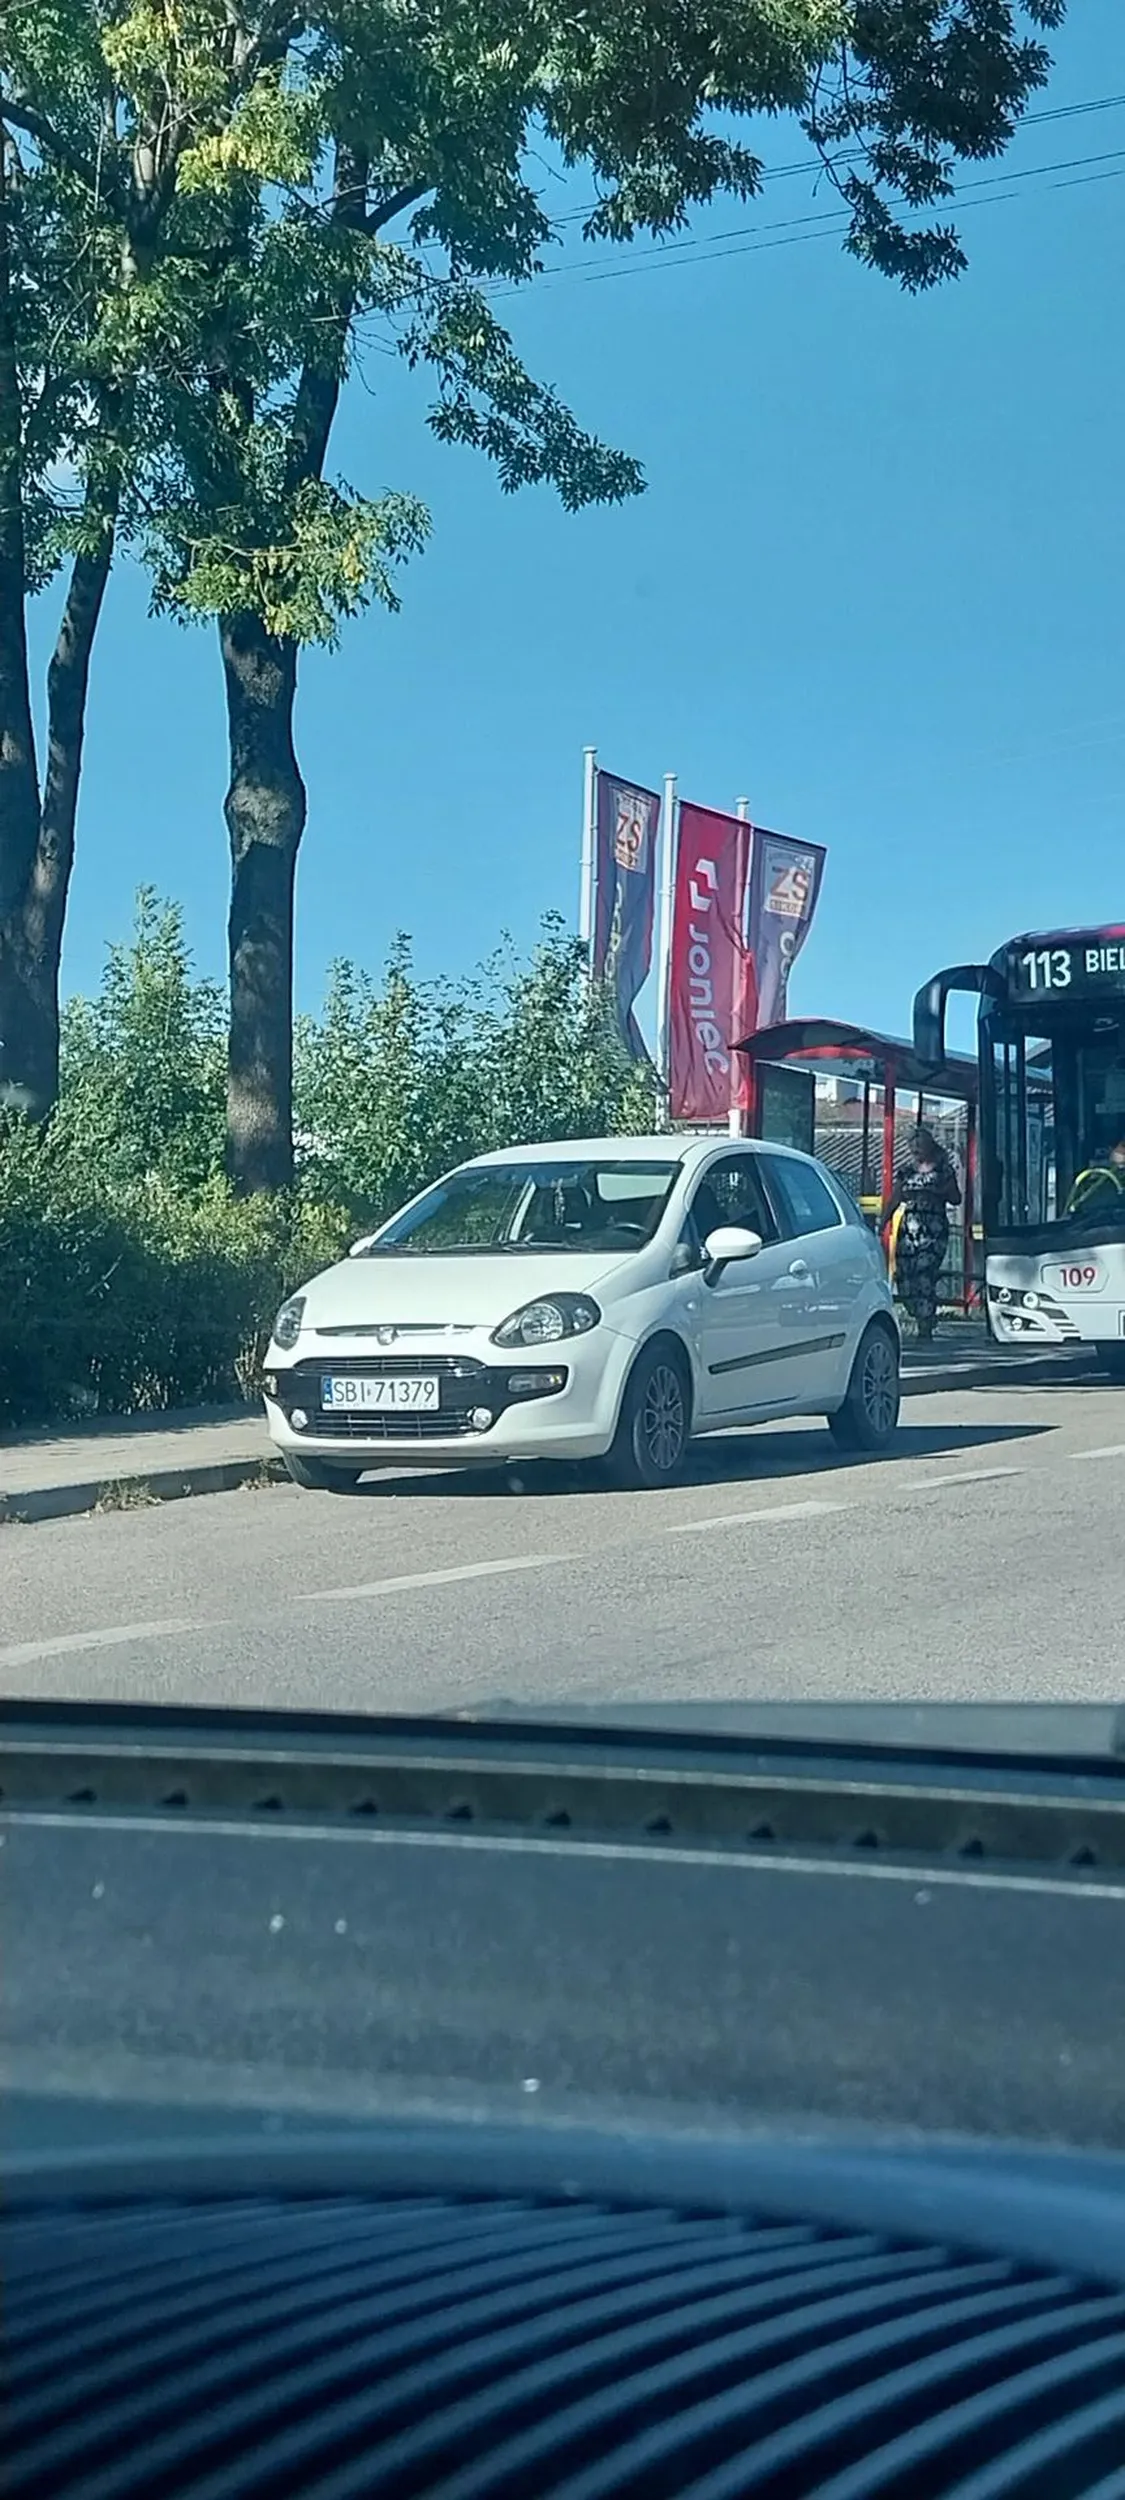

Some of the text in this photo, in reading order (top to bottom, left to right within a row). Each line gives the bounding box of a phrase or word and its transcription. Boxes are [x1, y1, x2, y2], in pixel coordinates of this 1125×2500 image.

[771, 865, 809, 901] ZS
[1022, 947, 1125, 989] 113 BIEL
[1059, 1267, 1096, 1287] 109
